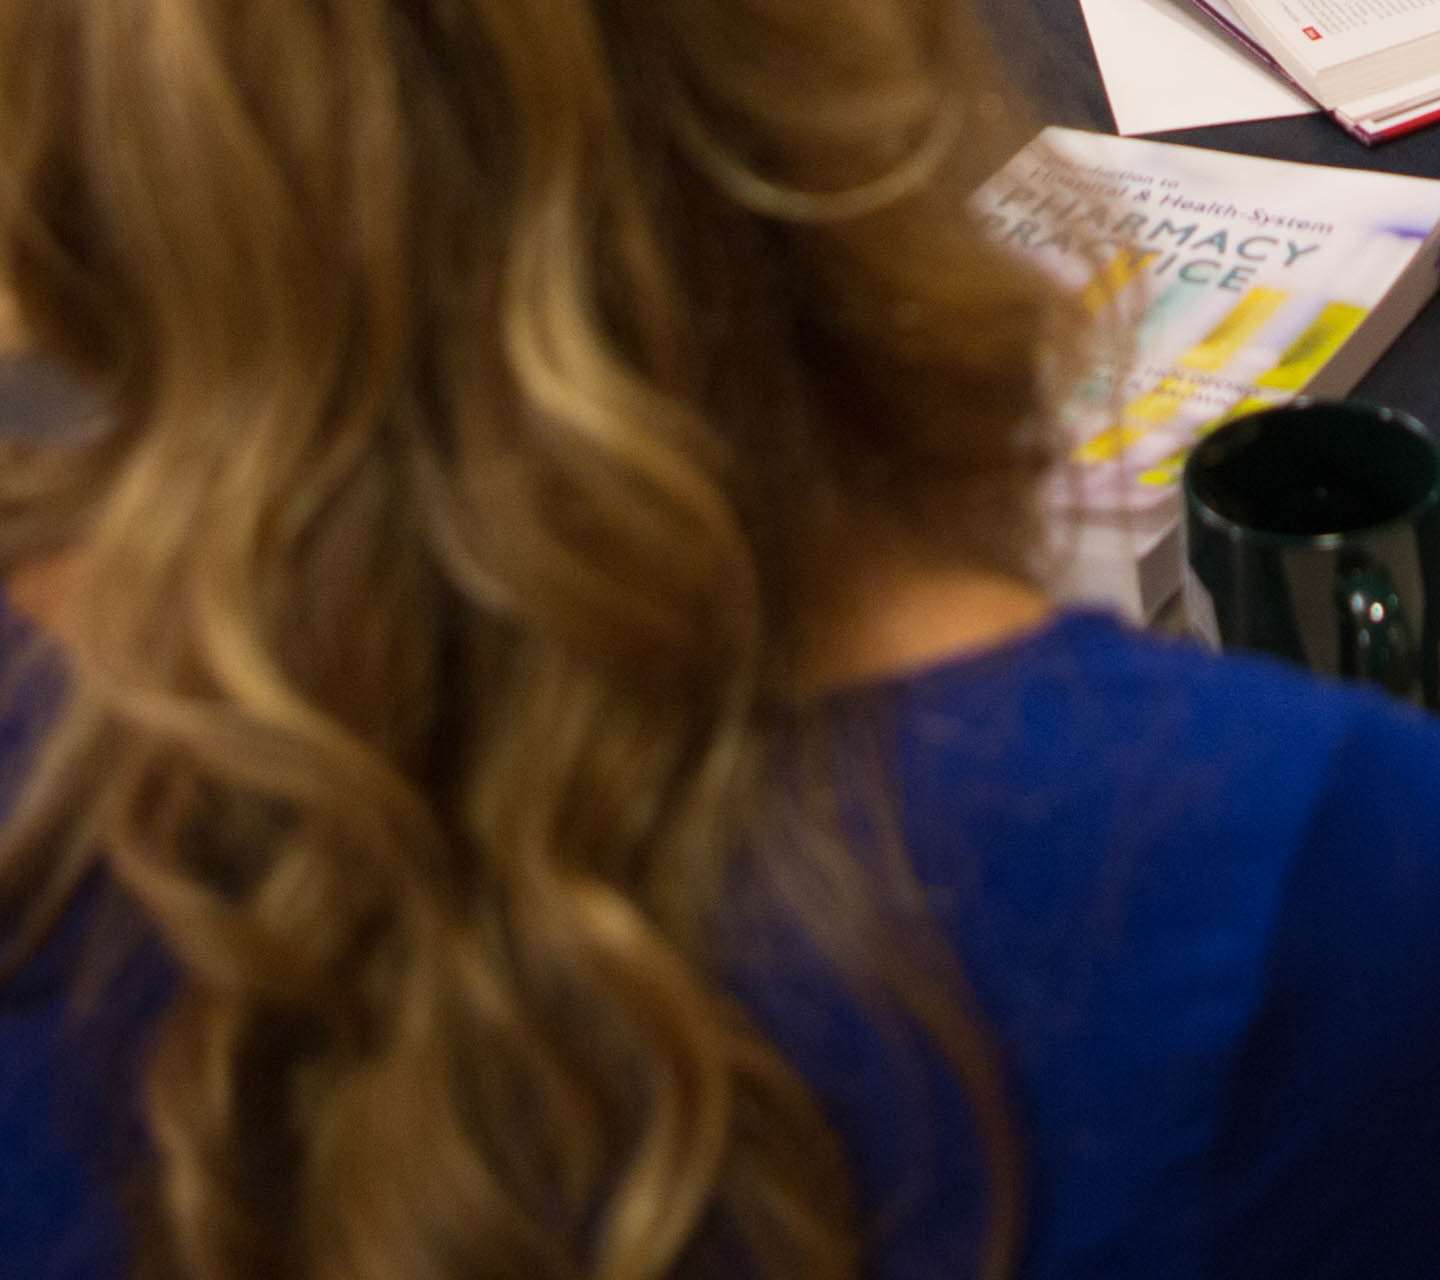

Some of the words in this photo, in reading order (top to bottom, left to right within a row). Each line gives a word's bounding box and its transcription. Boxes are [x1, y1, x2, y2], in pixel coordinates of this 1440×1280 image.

[1133, 188, 1152, 203] &
[1160, 192, 1334, 236] Health-System
[1160, 175, 1180, 190] to
[988, 216, 1259, 291] RATICE
[997, 184, 1320, 268] PHARMACY
